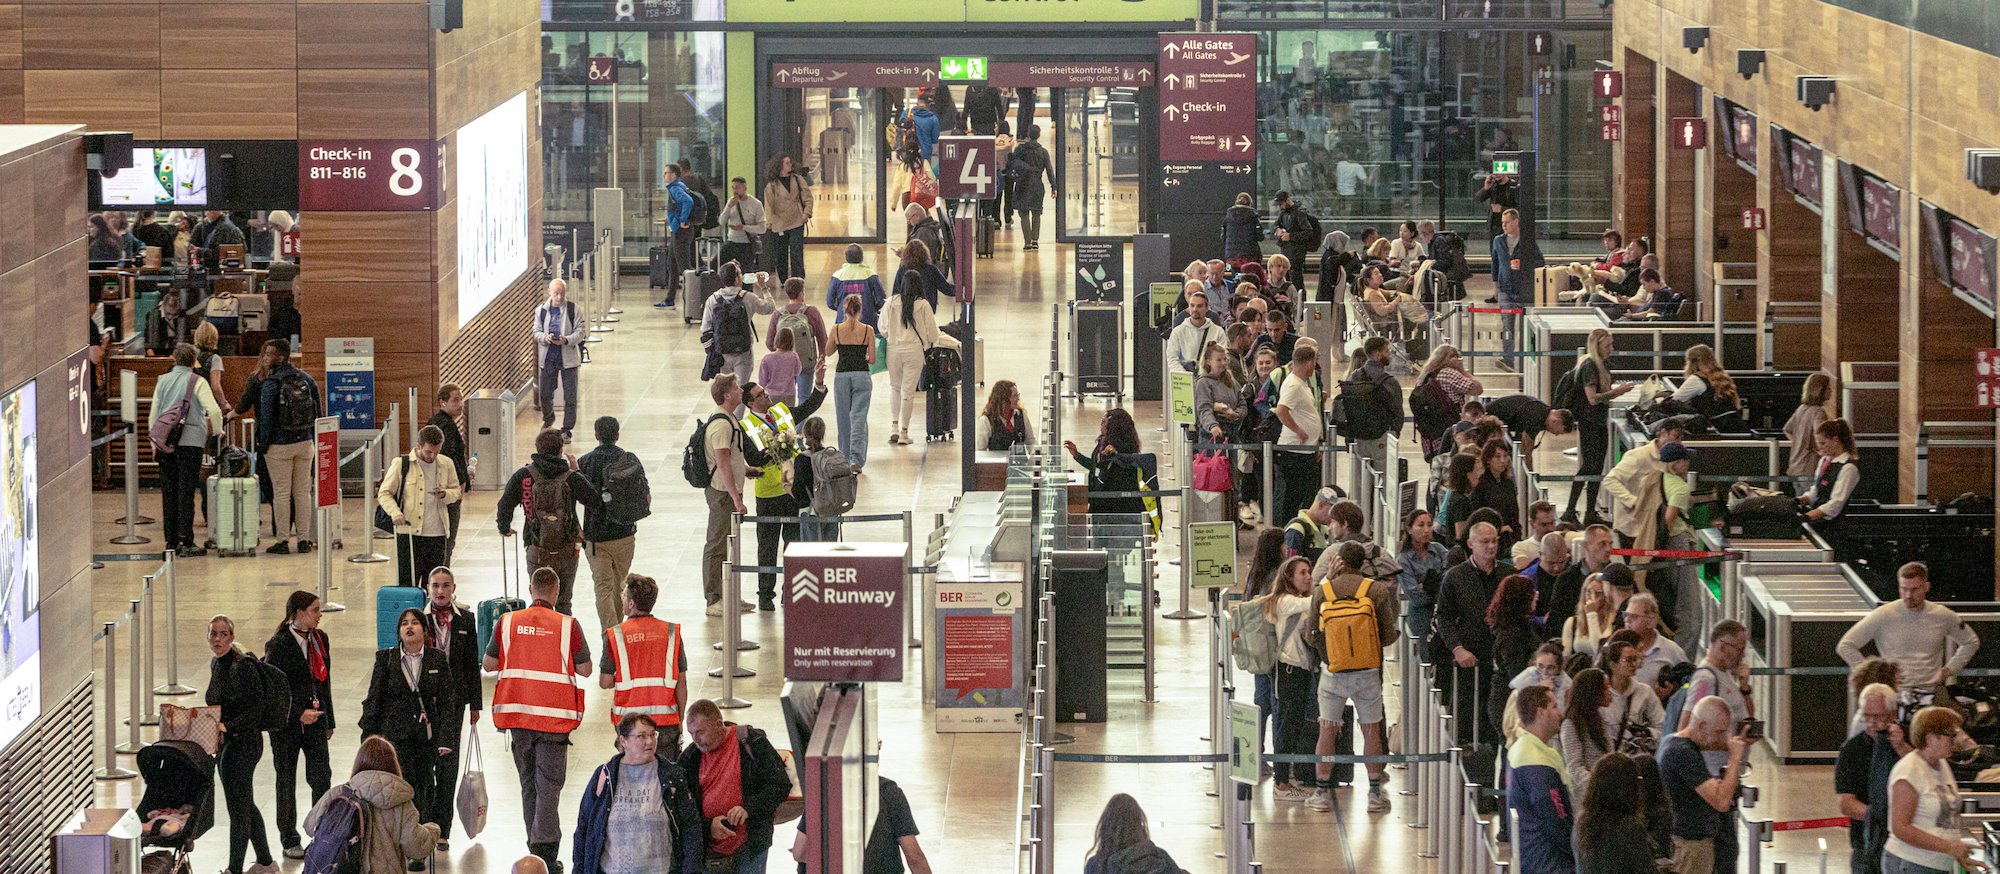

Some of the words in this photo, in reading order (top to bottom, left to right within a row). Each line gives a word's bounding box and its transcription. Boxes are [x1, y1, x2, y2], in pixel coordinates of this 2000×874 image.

[1182, 40, 1202, 50] Alle
[1205, 40, 1234, 50] Gates
[1195, 52, 1217, 60] Gates
[792, 66, 820, 77] Abflug
[876, 66, 911, 75] Check-in
[914, 67, 920, 75] 9
[1030, 66, 1112, 74] Sicherheitskontrolle
[1182, 102, 1226, 112] Check-in
[1182, 114, 1189, 122] 9
[310, 147, 372, 160] Check-in
[389, 147, 423, 196] 8
[310, 167, 366, 179] 811–816
[960, 148, 992, 193] 4
[81, 359, 88, 434] 6
[824, 568, 857, 584] BER
[824, 588, 896, 608] Runway
[940, 592, 963, 602] BER
[517, 625, 535, 635] BER
[627, 633, 645, 643] BER
[794, 647, 812, 656] Nur
[814, 647, 831, 656] mit
[833, 647, 896, 658] Reservierung
[794, 660, 811, 668] Only
